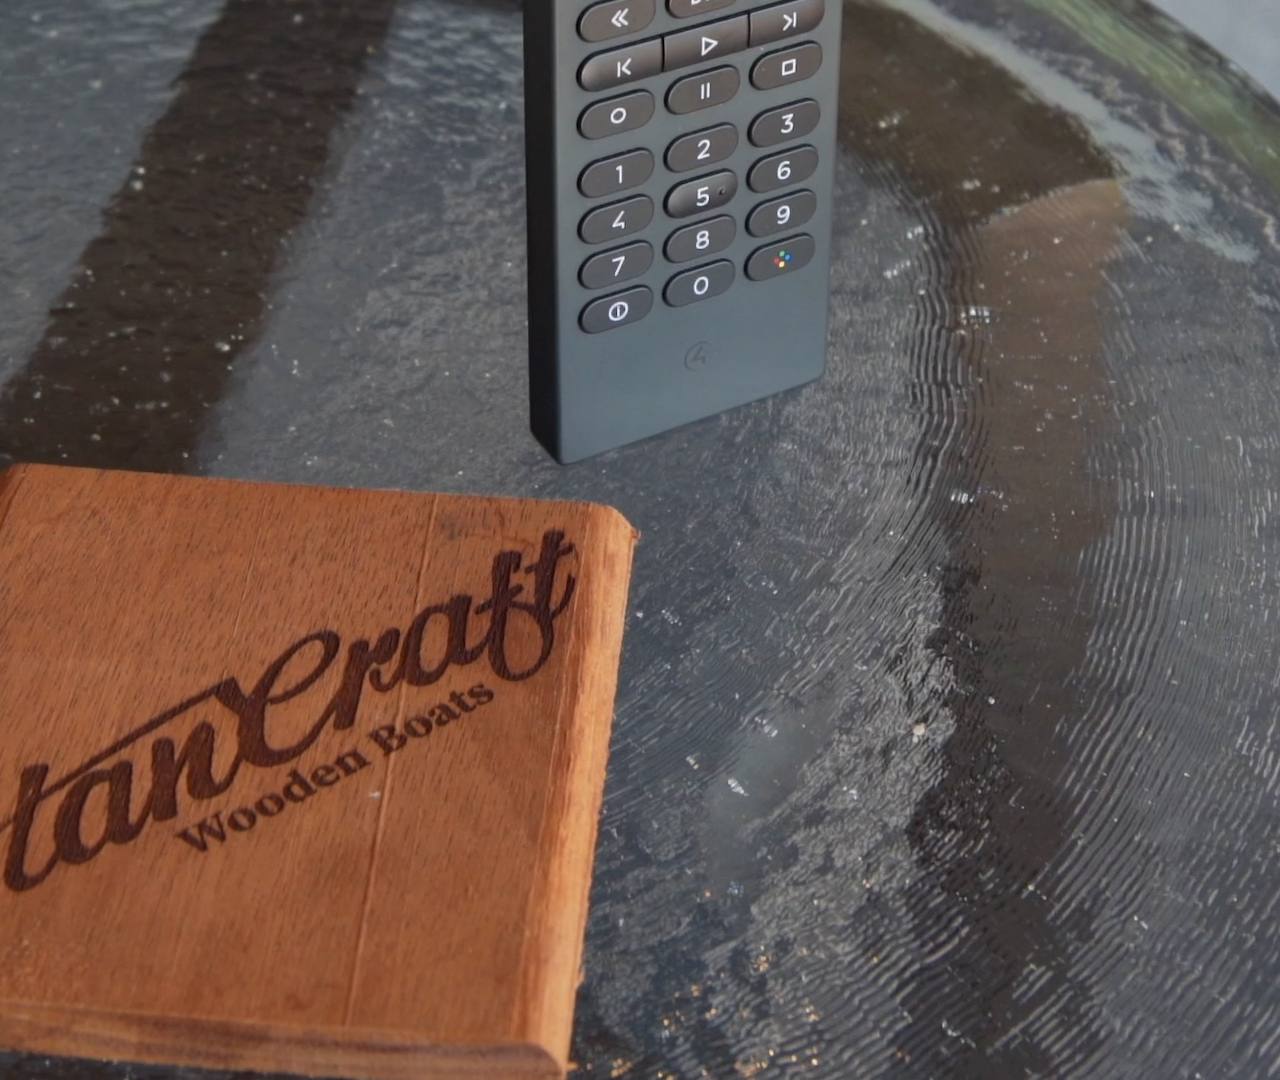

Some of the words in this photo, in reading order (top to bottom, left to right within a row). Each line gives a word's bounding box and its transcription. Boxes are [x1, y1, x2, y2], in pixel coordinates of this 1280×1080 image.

[780, 114, 794, 134] 3
[697, 140, 711, 160] 2
[615, 166, 623, 184] 1
[777, 161, 791, 180] 6
[696, 187, 710, 207] 5
[611, 211, 625, 229] 4
[776, 206, 791, 225] 9
[695, 231, 710, 250] 8
[611, 256, 626, 277] 7
[693, 277, 709, 295] 0
[174, 747, 372, 854] Wooden
[369, 678, 495, 760] Boats
